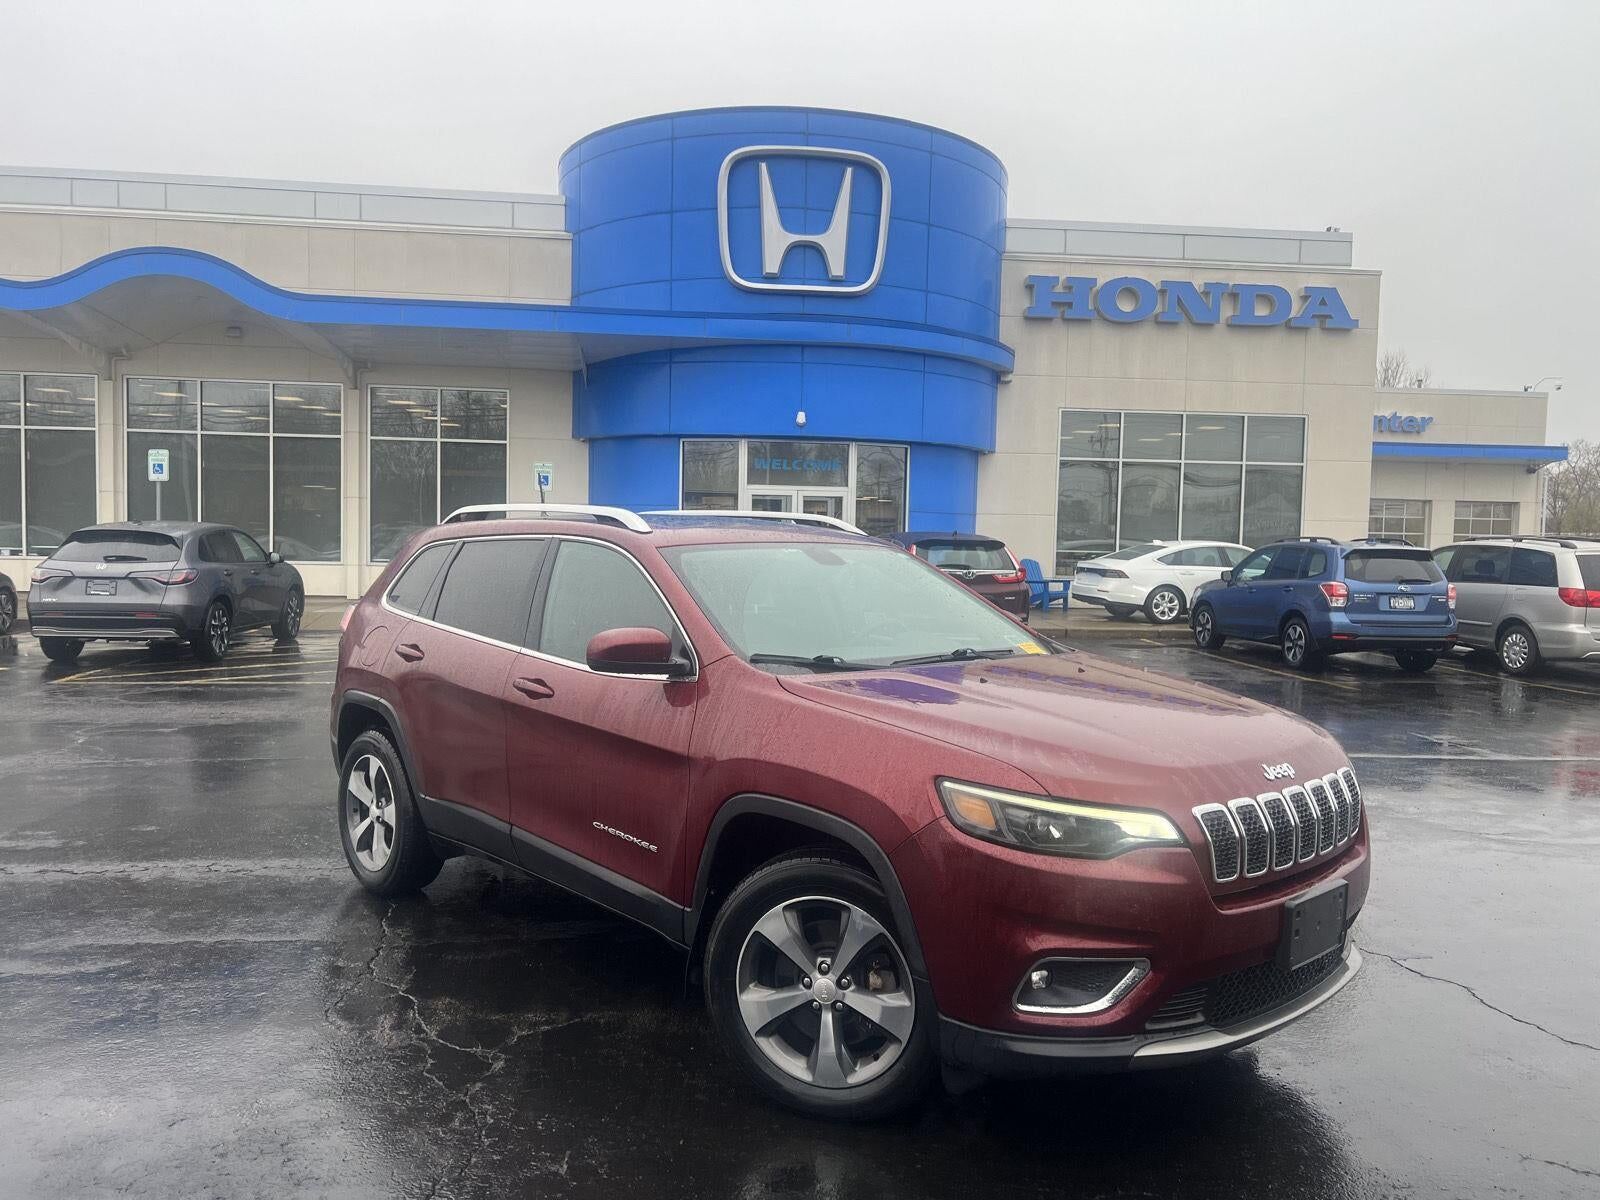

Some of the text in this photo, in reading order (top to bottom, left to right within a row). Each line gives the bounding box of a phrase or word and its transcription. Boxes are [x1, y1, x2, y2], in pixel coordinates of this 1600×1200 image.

[1024, 274, 1360, 330] HONDA
[1261, 762, 1296, 781] Jeep
[592, 821, 658, 853] CHEROKEE
